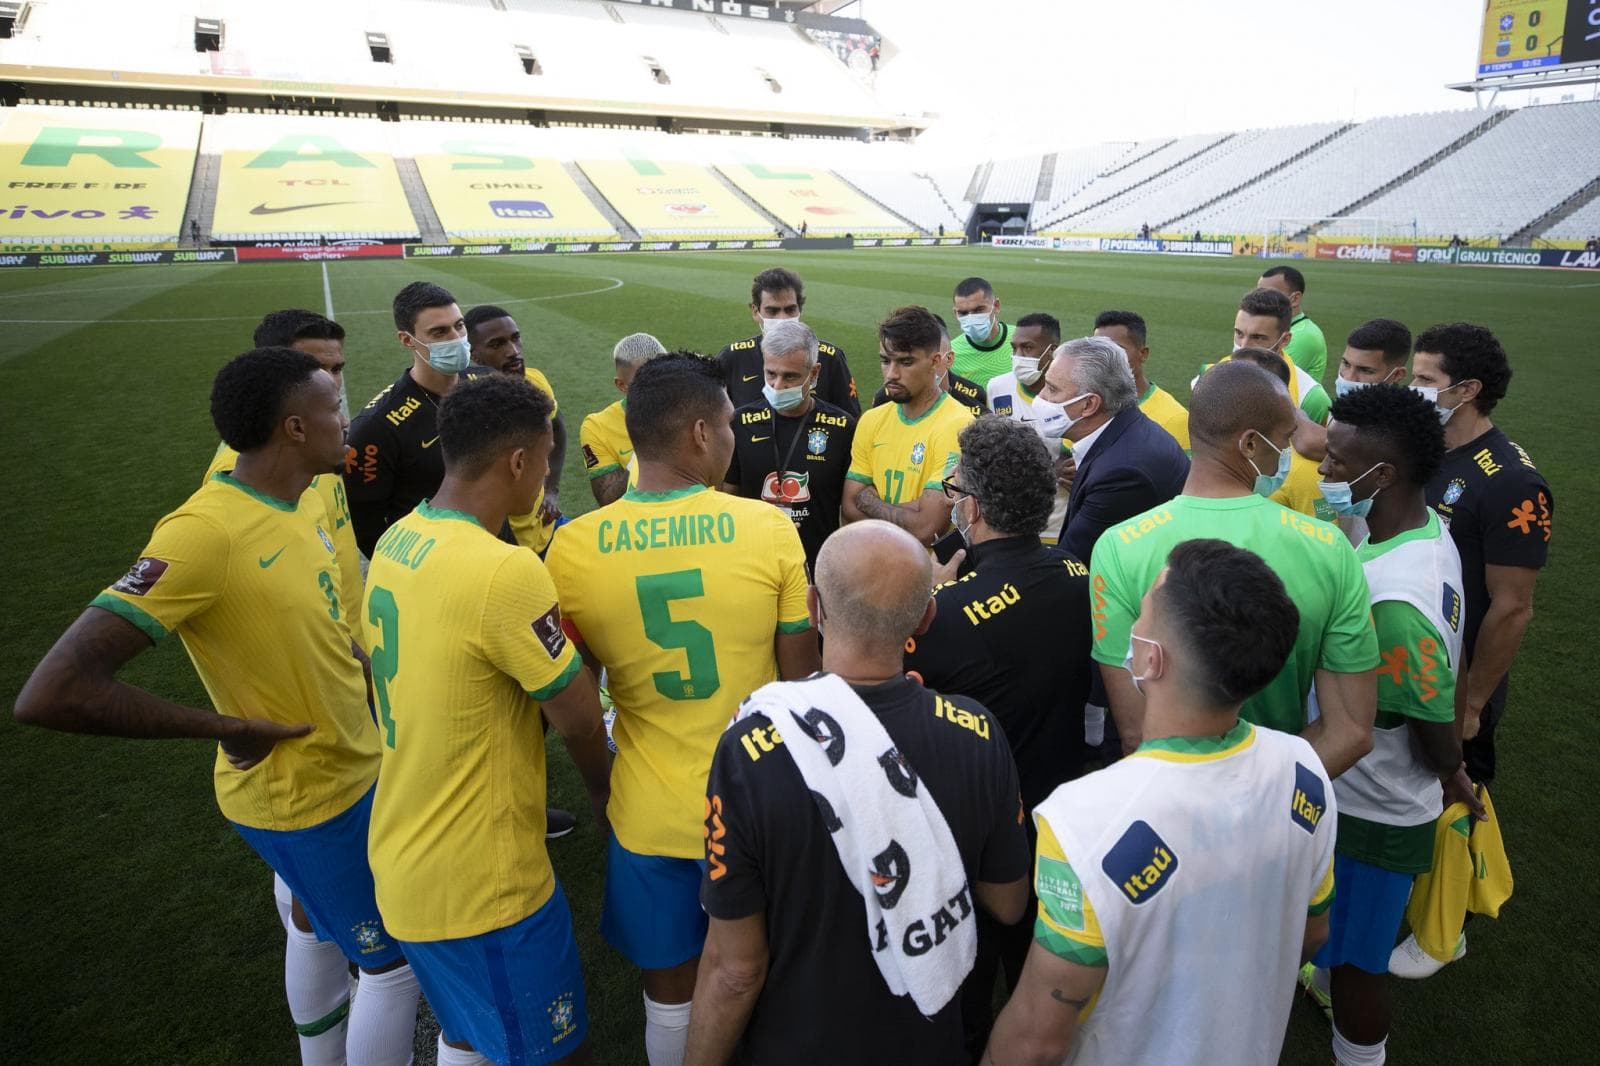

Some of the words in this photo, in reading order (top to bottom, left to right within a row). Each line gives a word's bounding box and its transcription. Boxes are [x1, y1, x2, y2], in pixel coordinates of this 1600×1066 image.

[1528, 10, 1541, 27] 0
[1526, 35, 1538, 51] 0
[8, 181, 77, 189] FREE
[0, 205, 106, 219] ivo
[413, 246, 455, 255] SUBWAY
[463, 245, 503, 254] SUBWAY
[510, 242, 549, 251] SUBWAY
[555, 243, 592, 252] SUBWAY
[1109, 239, 1159, 251] POTENCIAL
[39, 254, 97, 264] SUBWAY
[108, 252, 162, 262] SUBWAY
[172, 251, 224, 261] SUBWAY
[1417, 247, 1455, 262] grau
[1460, 251, 1490, 262] GRAU
[1493, 250, 1541, 264] TÉCNICO
[730, 340, 756, 351] Itaú
[817, 341, 836, 356] taú
[386, 396, 422, 426] Itaú
[741, 407, 771, 425] Itaú
[815, 412, 847, 427] Itaú
[358, 444, 378, 482] vivo
[1473, 448, 1503, 476] Itaú
[884, 468, 905, 503] 17
[598, 512, 735, 554] CASEMIRO
[376, 523, 436, 570] DANILO
[1063, 559, 1089, 577] Ita
[963, 583, 1021, 626] Itaú
[635, 568, 720, 701] 5
[368, 585, 399, 750] 2
[1412, 637, 1438, 702] vivo
[935, 695, 990, 741] Itaú
[740, 722, 785, 761] Ita
[1292, 788, 1322, 826] Itaú
[1123, 846, 1173, 899] Itaú
